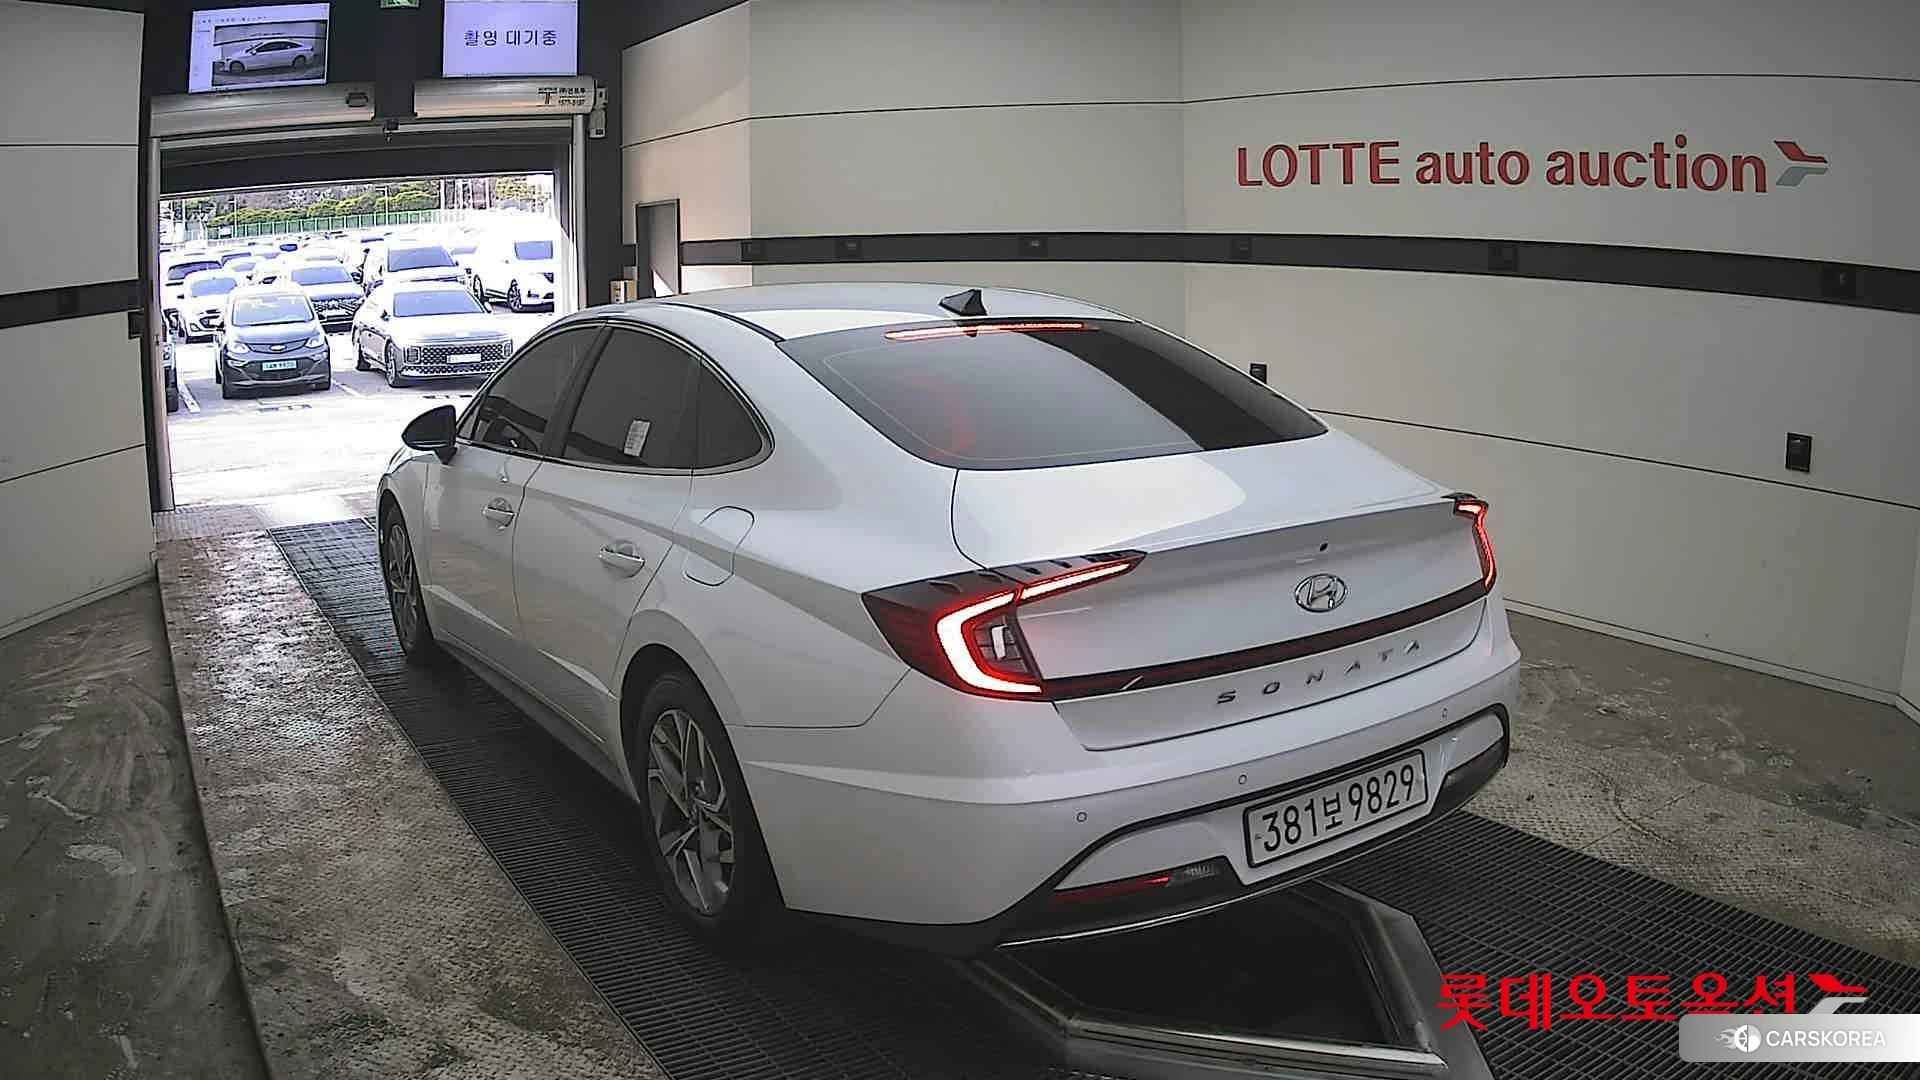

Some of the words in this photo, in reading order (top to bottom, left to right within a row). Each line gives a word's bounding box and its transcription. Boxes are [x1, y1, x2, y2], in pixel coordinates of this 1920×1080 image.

[505, 29, 558, 47] 대기중
[1236, 140, 1401, 188] LOTTE
[1414, 141, 1532, 186] auto
[1545, 134, 1768, 193] auction
[1217, 640, 1420, 704] SONATA
[1262, 765, 1414, 852] 381보9829
